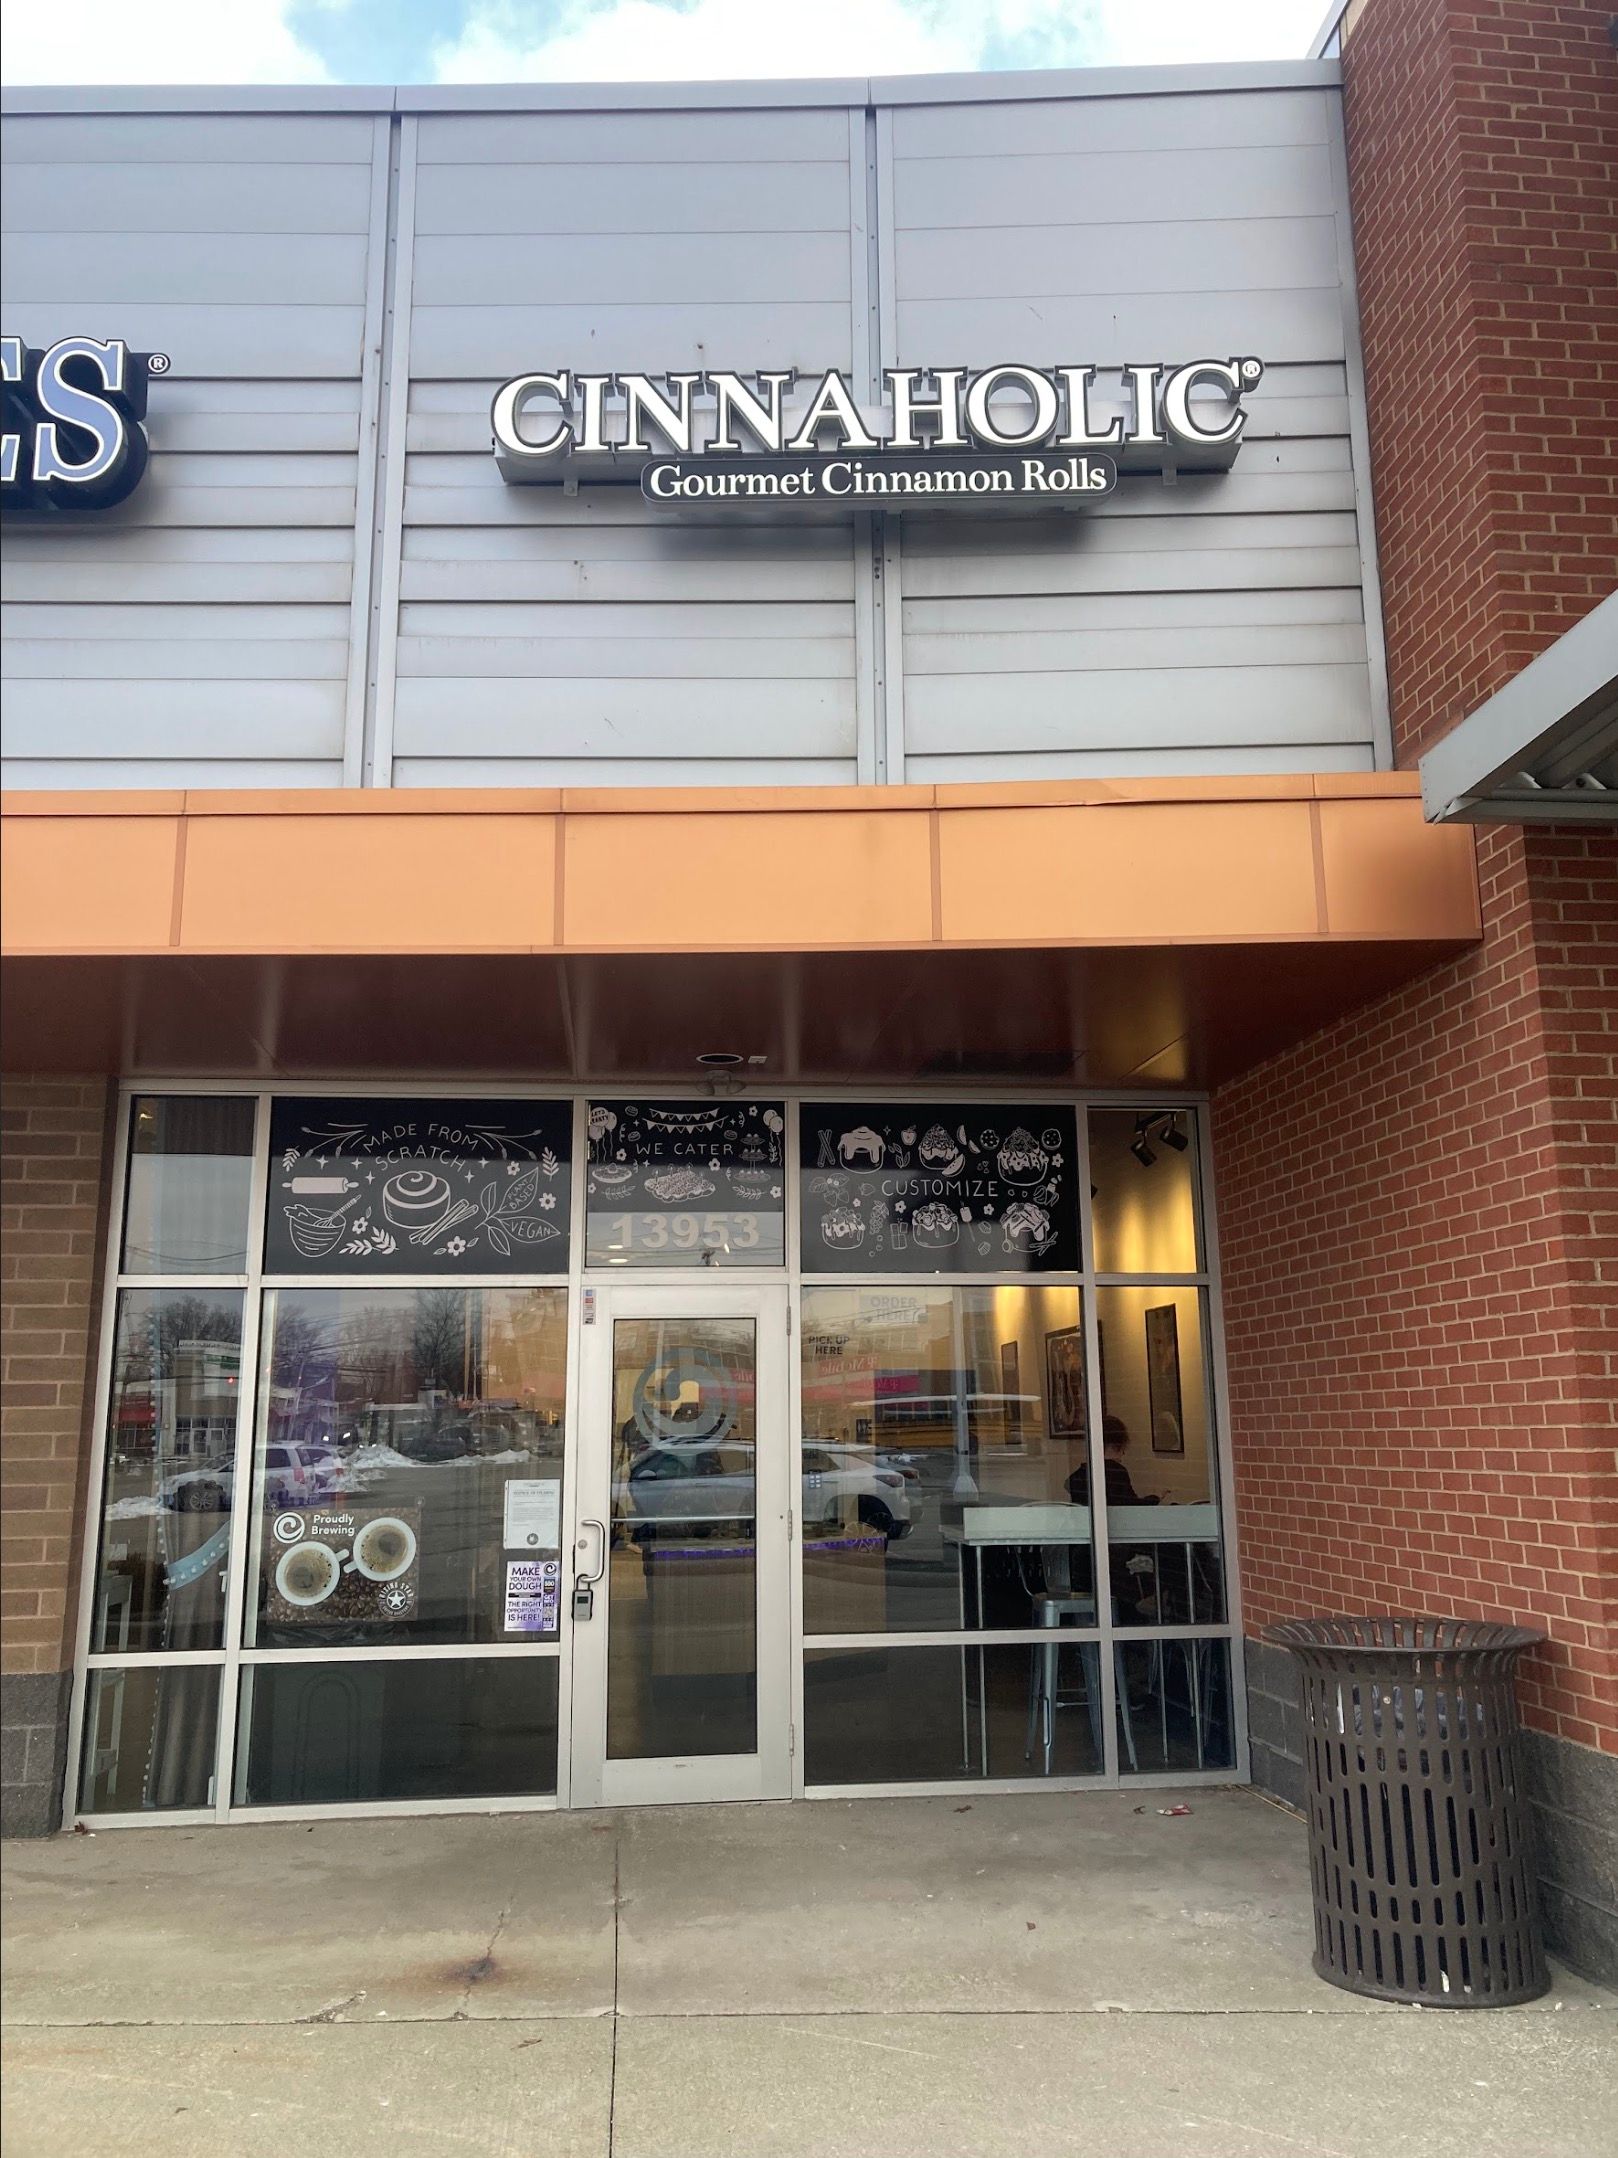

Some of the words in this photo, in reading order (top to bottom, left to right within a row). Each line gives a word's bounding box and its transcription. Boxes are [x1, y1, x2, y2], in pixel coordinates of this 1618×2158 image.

[649, 463, 815, 498] Gourmet
[820, 460, 1016, 496] Cinnamon
[1021, 457, 1108, 492] Rolls
[362, 1124, 418, 1155] MADE
[427, 1122, 480, 1152] FROM
[636, 1142, 664, 1155] WE
[673, 1142, 735, 1156] CATER
[374, 1145, 468, 1173] SCRATCH
[507, 1179, 530, 1200] PLANT
[881, 1179, 999, 1198] CUSTOMIZE
[509, 1183, 535, 1210] BASED
[511, 1220, 552, 1239] VEGAN
[611, 1214, 761, 1249] 13953
[870, 1296, 918, 1308] ORDER
[808, 1336, 833, 1345] PICK
[835, 1335, 850, 1345] UP
[815, 1346, 844, 1355] HERE
[313, 1513, 355, 1525] Proudly
[311, 1525, 355, 1537] Brewing
[511, 1567, 541, 1576] MAKE
[508, 1582, 542, 1591] DOUGH
[521, 1600, 541, 1608] RIGHT
[508, 1614, 516, 1622] IS
[516, 1613, 540, 1622] HERE!
